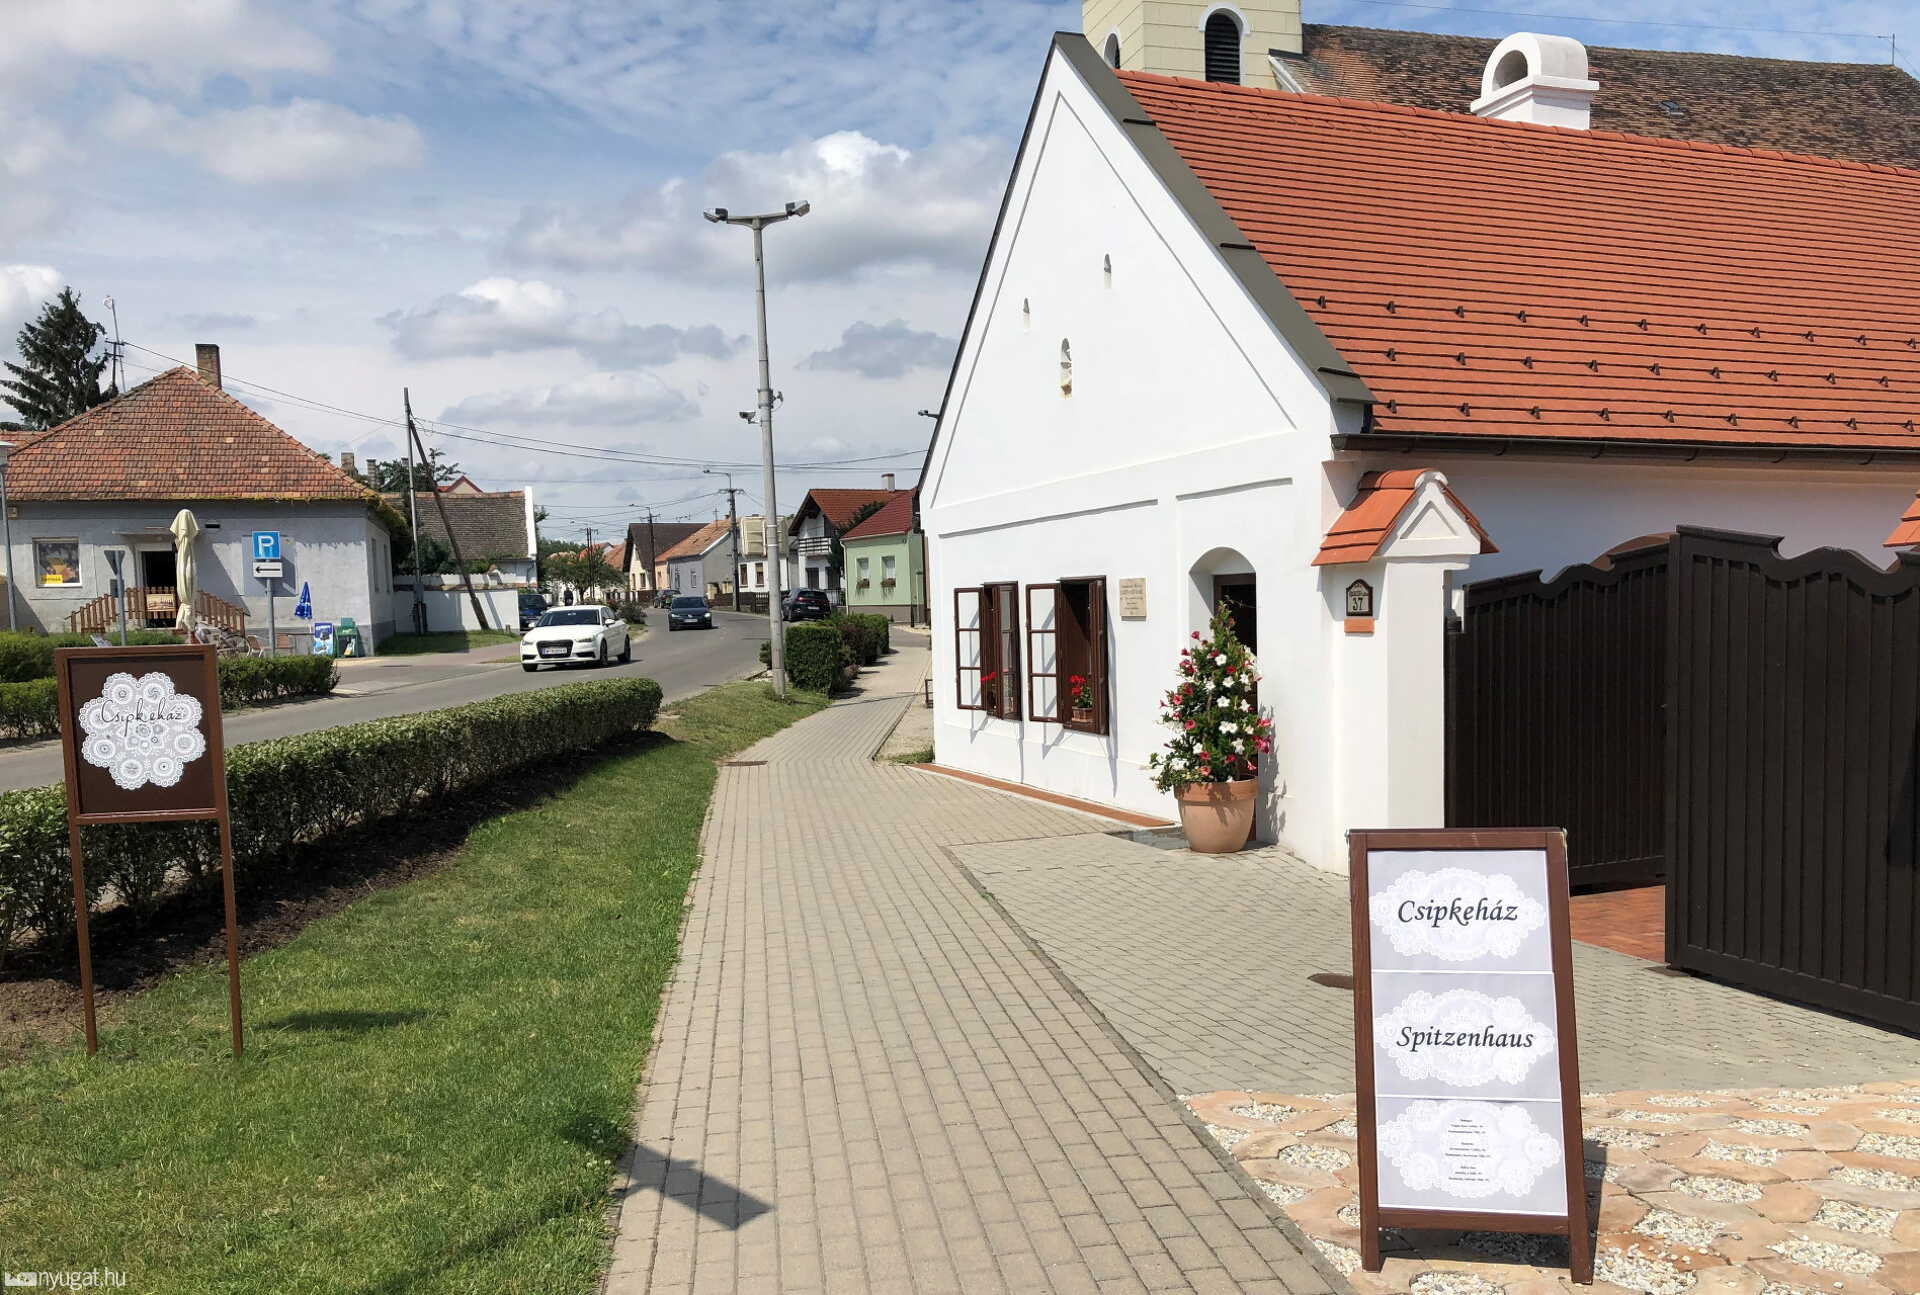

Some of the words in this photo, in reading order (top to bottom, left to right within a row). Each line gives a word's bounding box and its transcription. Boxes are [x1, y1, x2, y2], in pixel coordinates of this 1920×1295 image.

[258, 535, 274, 558] P
[1352, 597, 1363, 610] 37
[101, 699, 182, 736] Csipkeház
[1397, 898, 1518, 927] Csipkeház
[1396, 1025, 1534, 1051] Spitzenhaus
